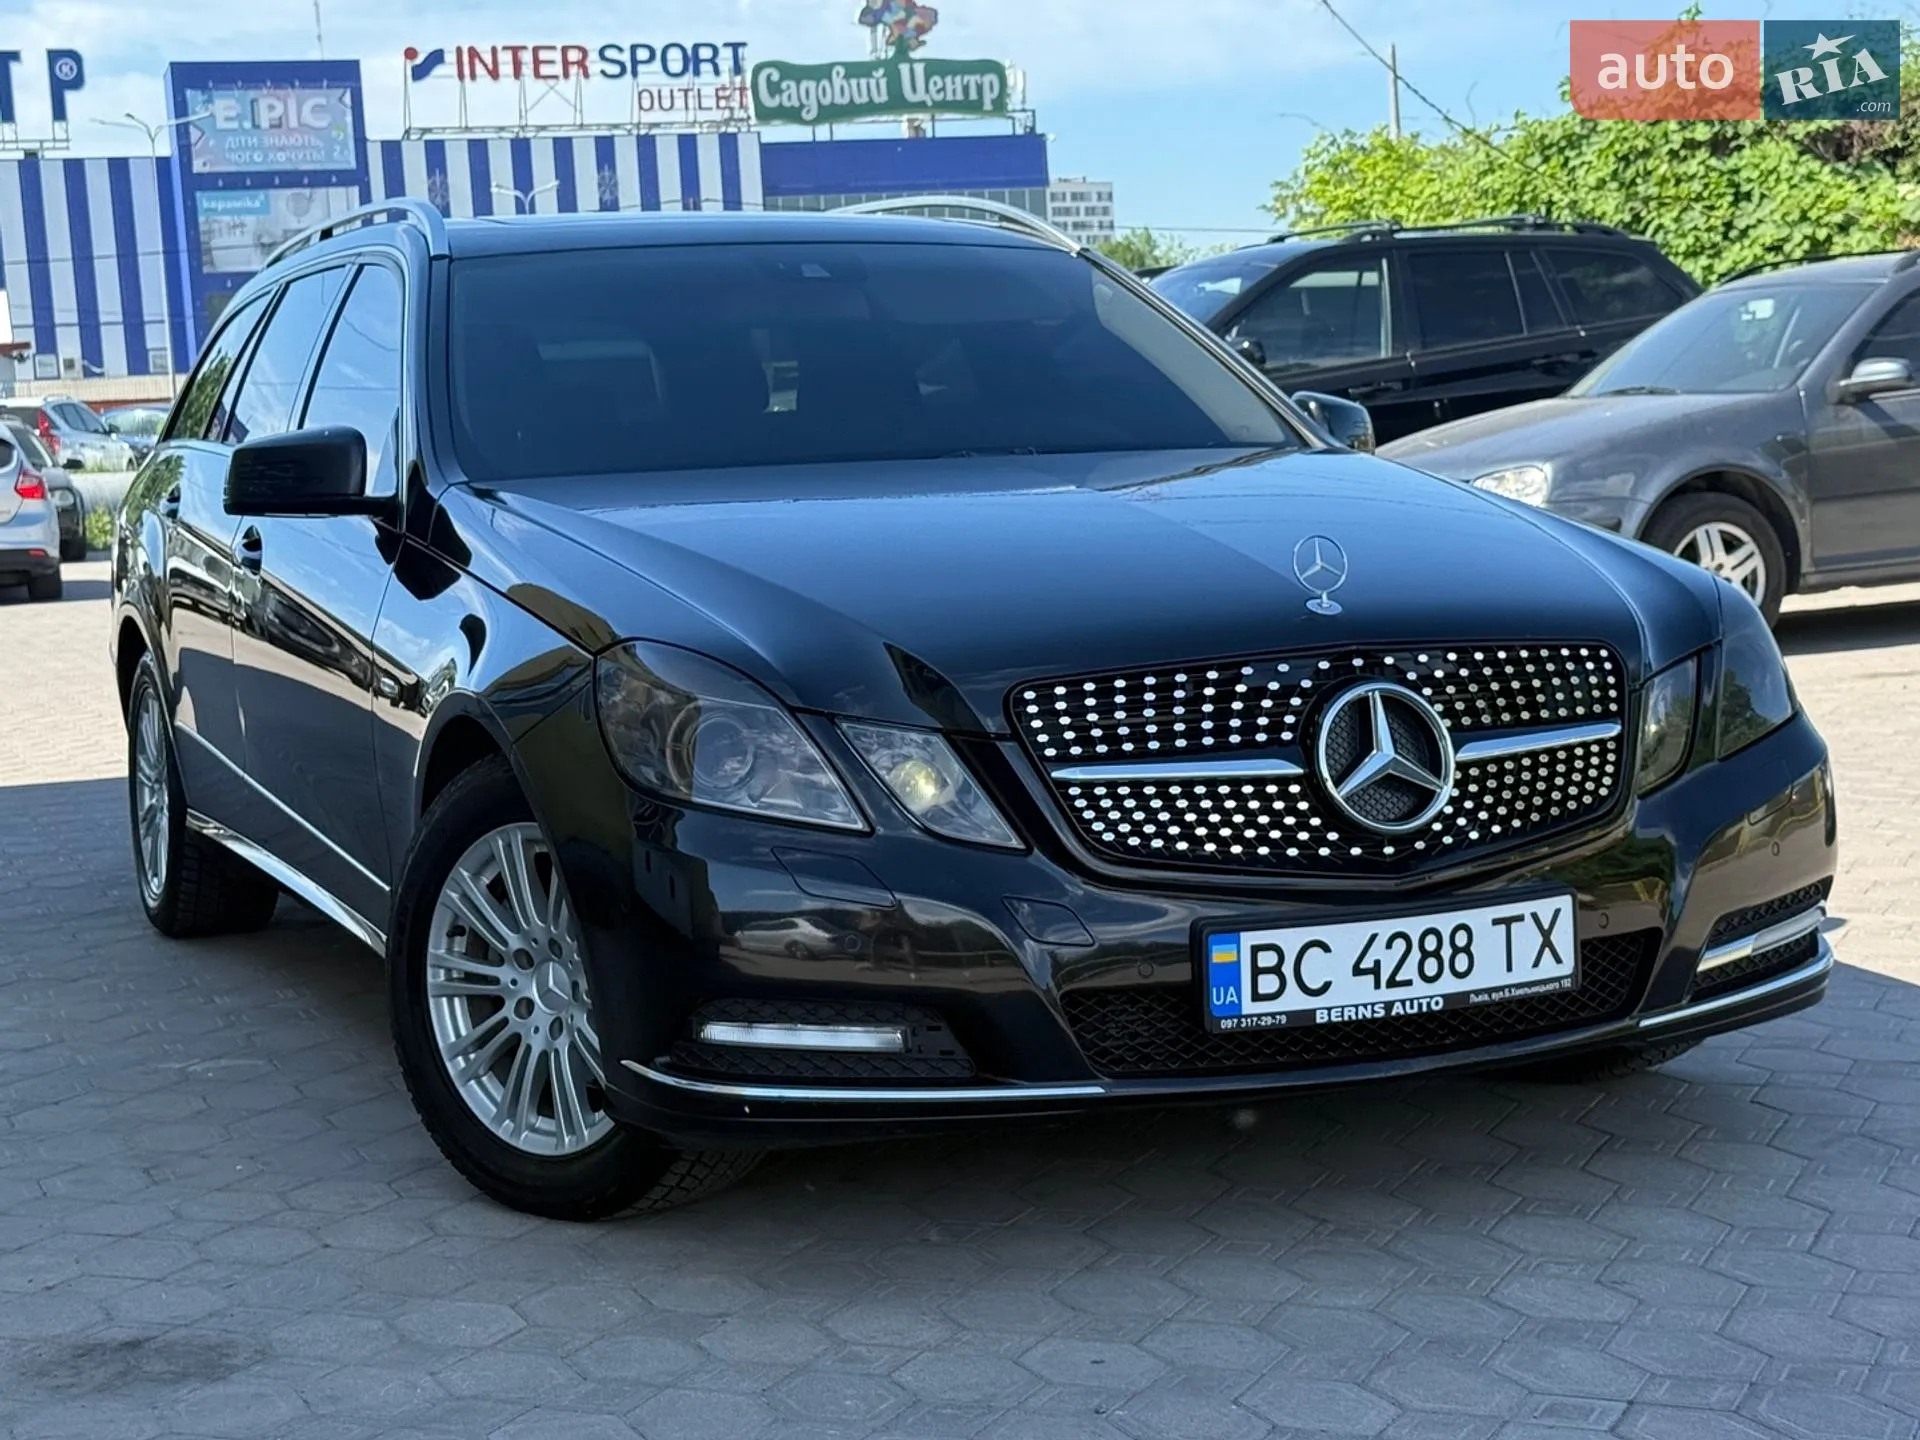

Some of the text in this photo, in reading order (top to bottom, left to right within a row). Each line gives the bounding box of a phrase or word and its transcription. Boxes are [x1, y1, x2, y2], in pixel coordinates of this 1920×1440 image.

[638, 84, 748, 112] OUTLET
[757, 62, 1000, 121] Садовий Центр
[1250, 908, 1563, 1002] BC 4288 TX
[1212, 986, 1238, 1005] UA
[1221, 1014, 1287, 1029] 097 317-29-79
[1315, 996, 1444, 1024] BERNS AUTO
